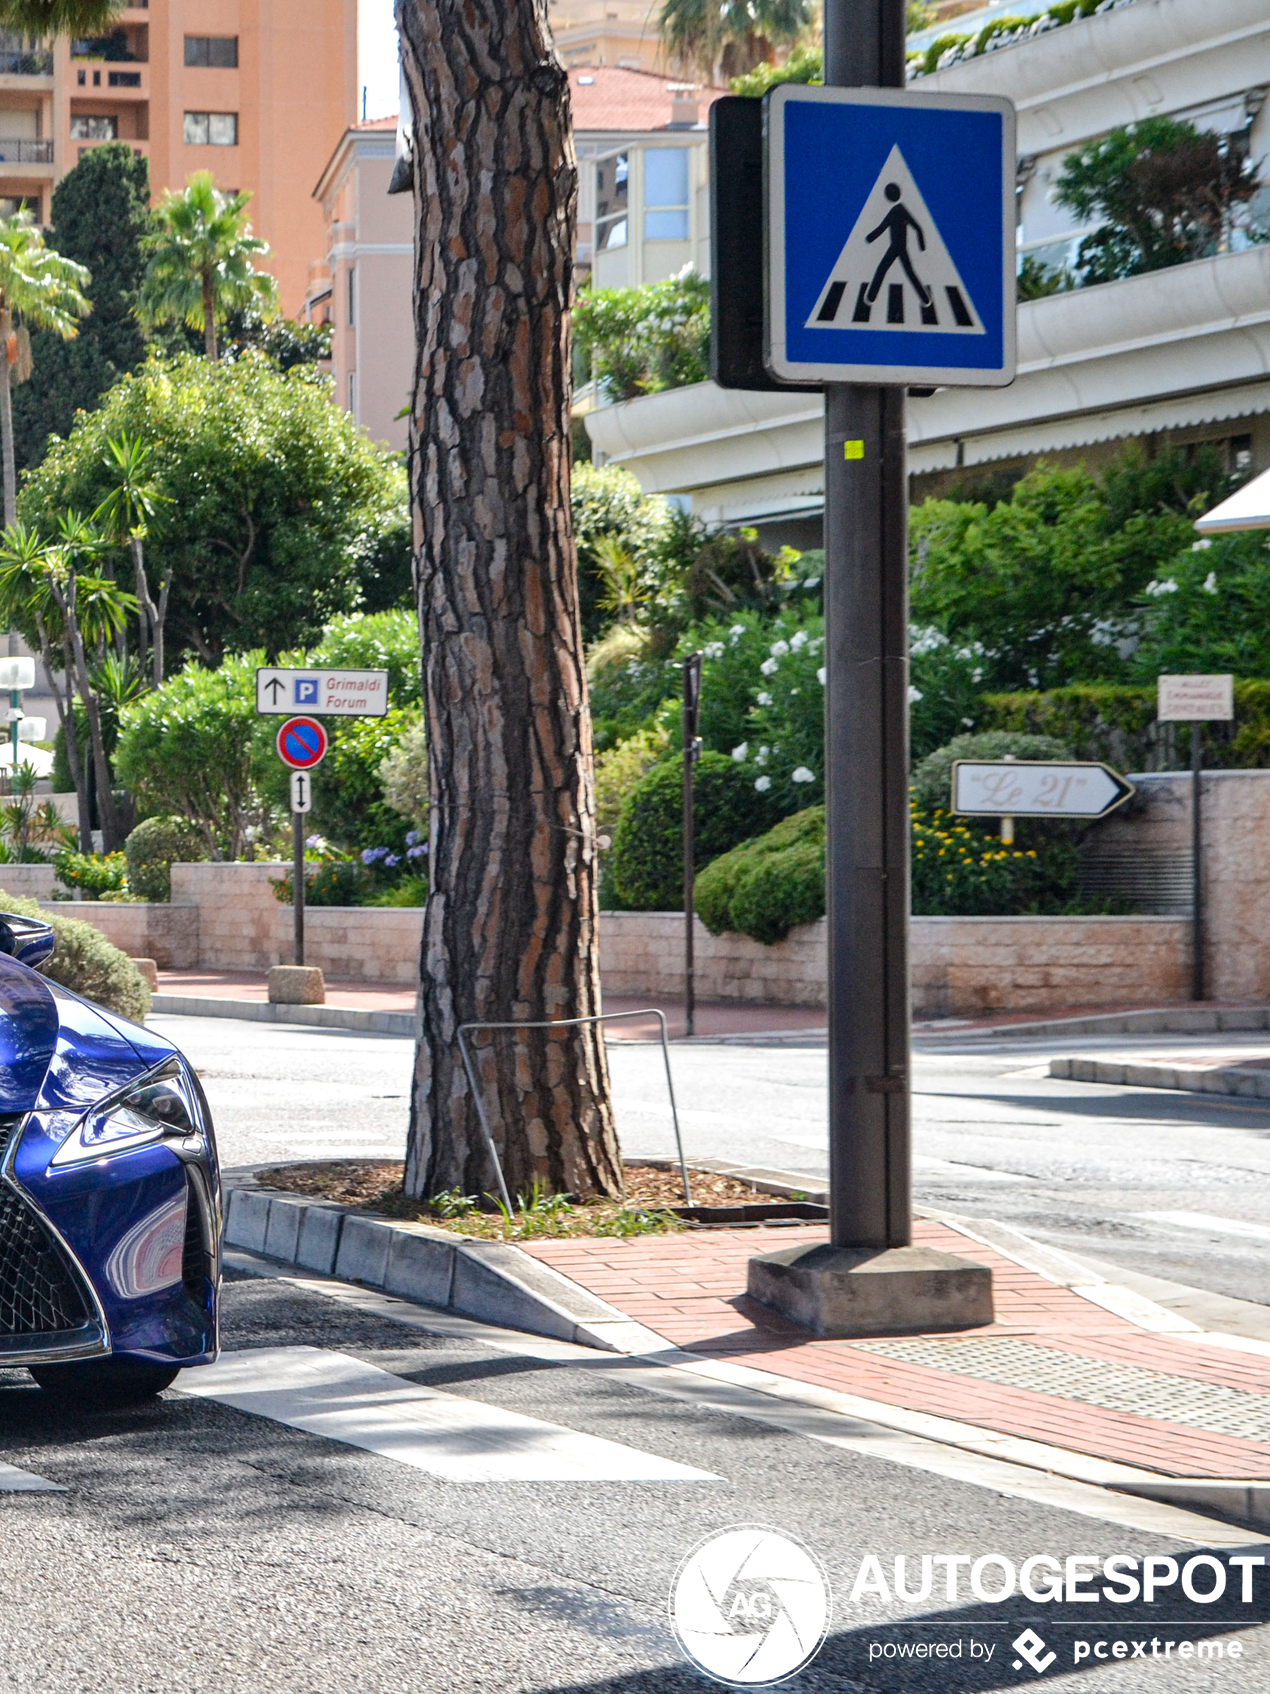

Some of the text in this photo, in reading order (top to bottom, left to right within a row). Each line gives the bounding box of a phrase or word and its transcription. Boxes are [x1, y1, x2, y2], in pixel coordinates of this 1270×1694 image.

[299, 683, 314, 701] P
[326, 677, 382, 692] Grimaldi
[326, 695, 367, 708] Forum
